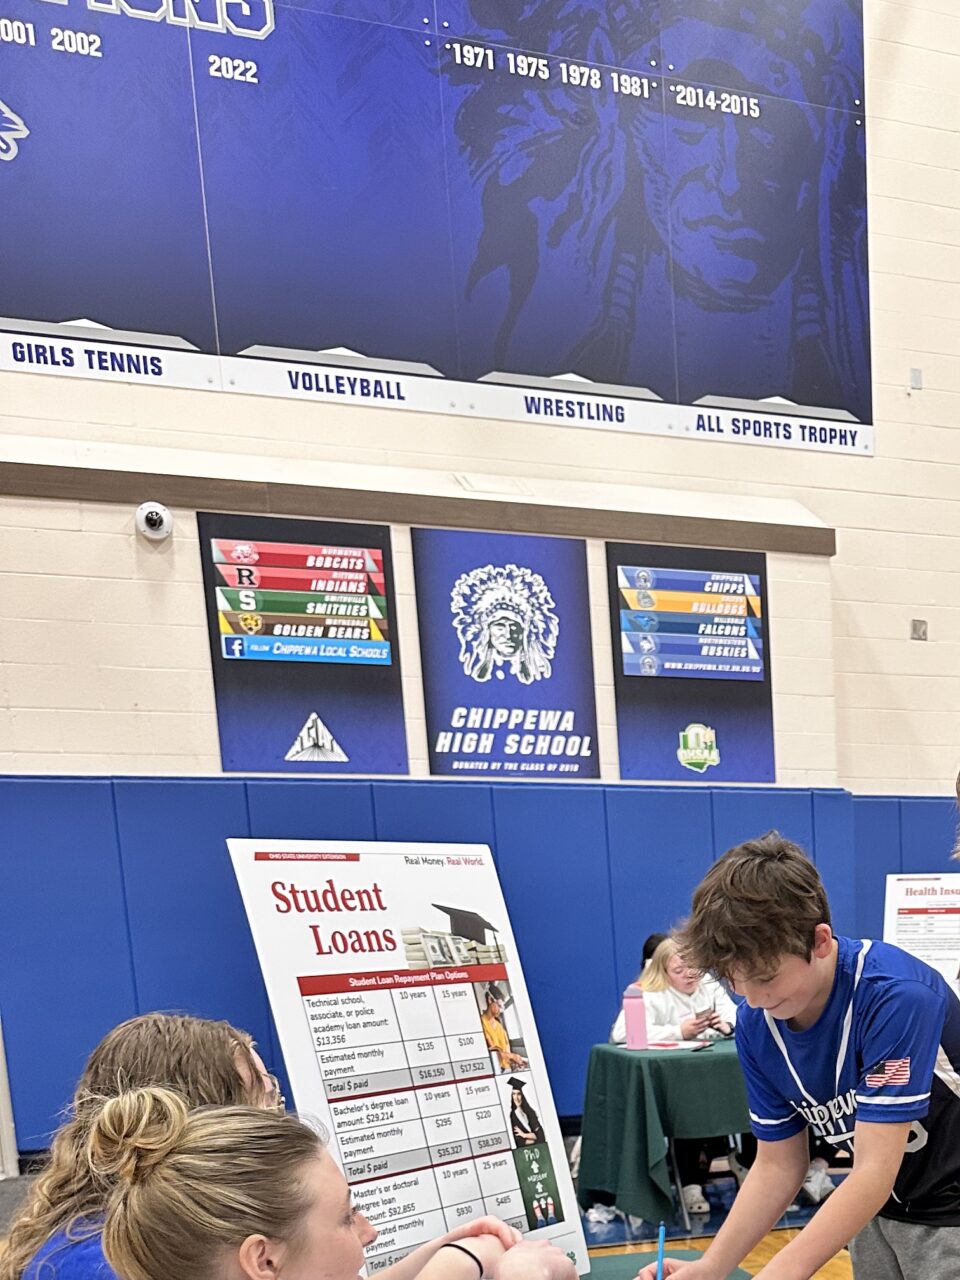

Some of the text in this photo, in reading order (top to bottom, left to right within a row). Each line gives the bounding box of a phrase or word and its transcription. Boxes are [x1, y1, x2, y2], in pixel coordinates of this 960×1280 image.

[0, 19, 36, 46] 001
[50, 27, 103, 58] 2002
[208, 54, 259, 84] 2022
[453, 43, 760, 118] 1971 1975 1978 1981 2014-2015
[11, 341, 163, 377] GIRLS TENNIS
[287, 370, 406, 401] VOLLEYBALL
[524, 395, 626, 424] WRESTLING
[696, 414, 859, 447] ALL SPORTS TROPHY
[306, 555, 364, 570] BOBCATS
[237, 567, 256, 586] R
[310, 579, 367, 593] INDIANS
[704, 582, 744, 594] CHIPPS
[239, 590, 256, 611] S
[306, 602, 368, 617] SMITHIES
[691, 602, 746, 615] BULLDOGS
[273, 624, 370, 640] GOLDEN BEARS
[698, 624, 747, 637] FALCONS
[701, 645, 748, 658] HUSKIES
[450, 706, 576, 732] CHIPPEWA
[435, 732, 592, 757] HIGH SCHOOL
[452, 761, 489, 770] DONATED
[490, 762, 502, 771] BY
[504, 762, 518, 771] THE
[520, 763, 545, 772] CLASS
[546, 763, 557, 772] OF
[405, 856, 485, 867] Real Money. Real World.
[271, 879, 388, 914] Student
[905, 886, 937, 897] Health
[309, 924, 398, 956] Loans
[348, 970, 469, 987] Student Loan Repayment Plan Options
[399, 991, 427, 1001] 10 years
[452, 989, 468, 999] years
[306, 996, 365, 1009] Technical school,
[310, 1011, 345, 1021] associate,
[355, 1007, 375, 1018] police
[313, 1023, 344, 1034] academy
[346, 1020, 361, 1030] loan
[316, 1034, 346, 1047] $13,356
[417, 1042, 434, 1052] $135
[458, 1036, 474, 1047] $100
[320, 1048, 384, 1064] Estimated monthly
[323, 1066, 355, 1078] payment
[419, 1068, 445, 1080] $16,150
[460, 1061, 485, 1073] $17,522
[327, 1080, 369, 1093] Total $ paid
[424, 1091, 451, 1101] 10 years
[333, 1097, 409, 1116] Bachelor's degree loan
[366, 1111, 394, 1124] $29,214
[476, 1110, 492, 1120] $220
[435, 1118, 452, 1128] $295
[340, 1127, 403, 1146] Estimated monthly
[344, 1145, 374, 1159] payment
[523, 1148, 540, 1162] PhD
[365, 1238, 396, 1254] payment
